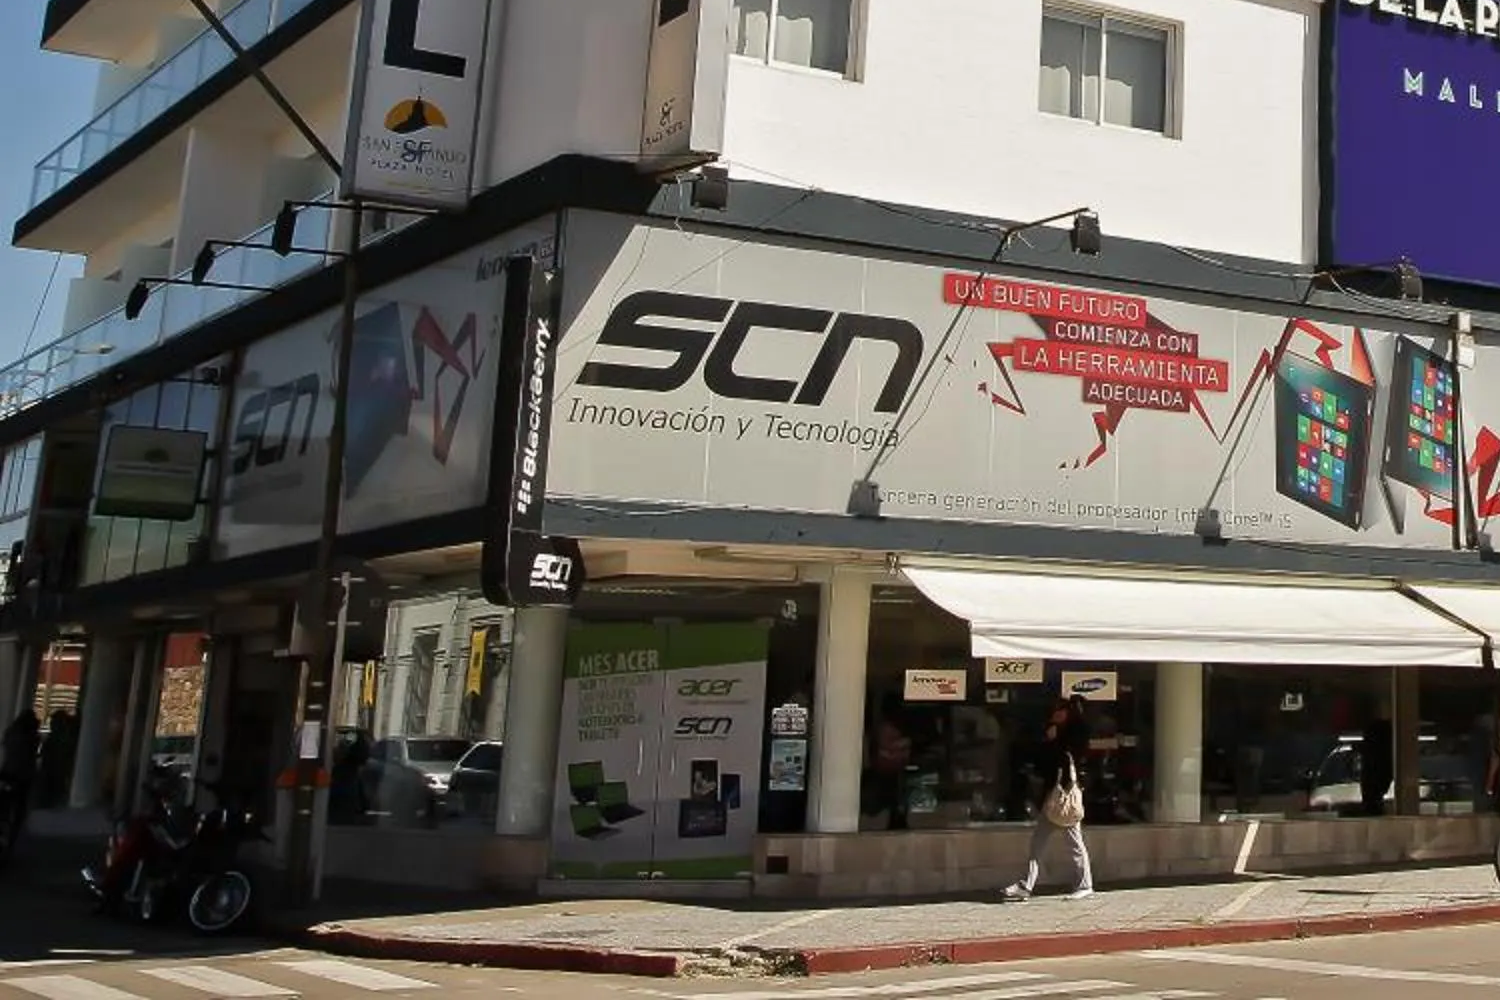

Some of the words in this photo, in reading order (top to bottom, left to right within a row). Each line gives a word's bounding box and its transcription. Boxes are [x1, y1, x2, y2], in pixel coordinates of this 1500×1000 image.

[954, 279, 985, 301] UN
[993, 285, 1051, 310] BUEN
[1058, 293, 1140, 320] FUTURO
[1054, 321, 1151, 349] COMIENZA
[1157, 334, 1193, 354] CON
[1020, 346, 1049, 367] LA
[1058, 352, 1220, 385] HERRAMIENTA
[1087, 383, 1184, 408] ADECUADA
[566, 398, 727, 434] Innovación
[735, 416, 753, 440] y
[765, 414, 900, 452] Tecnología
[615, 649, 660, 671] ACER
[677, 678, 743, 697] acer
